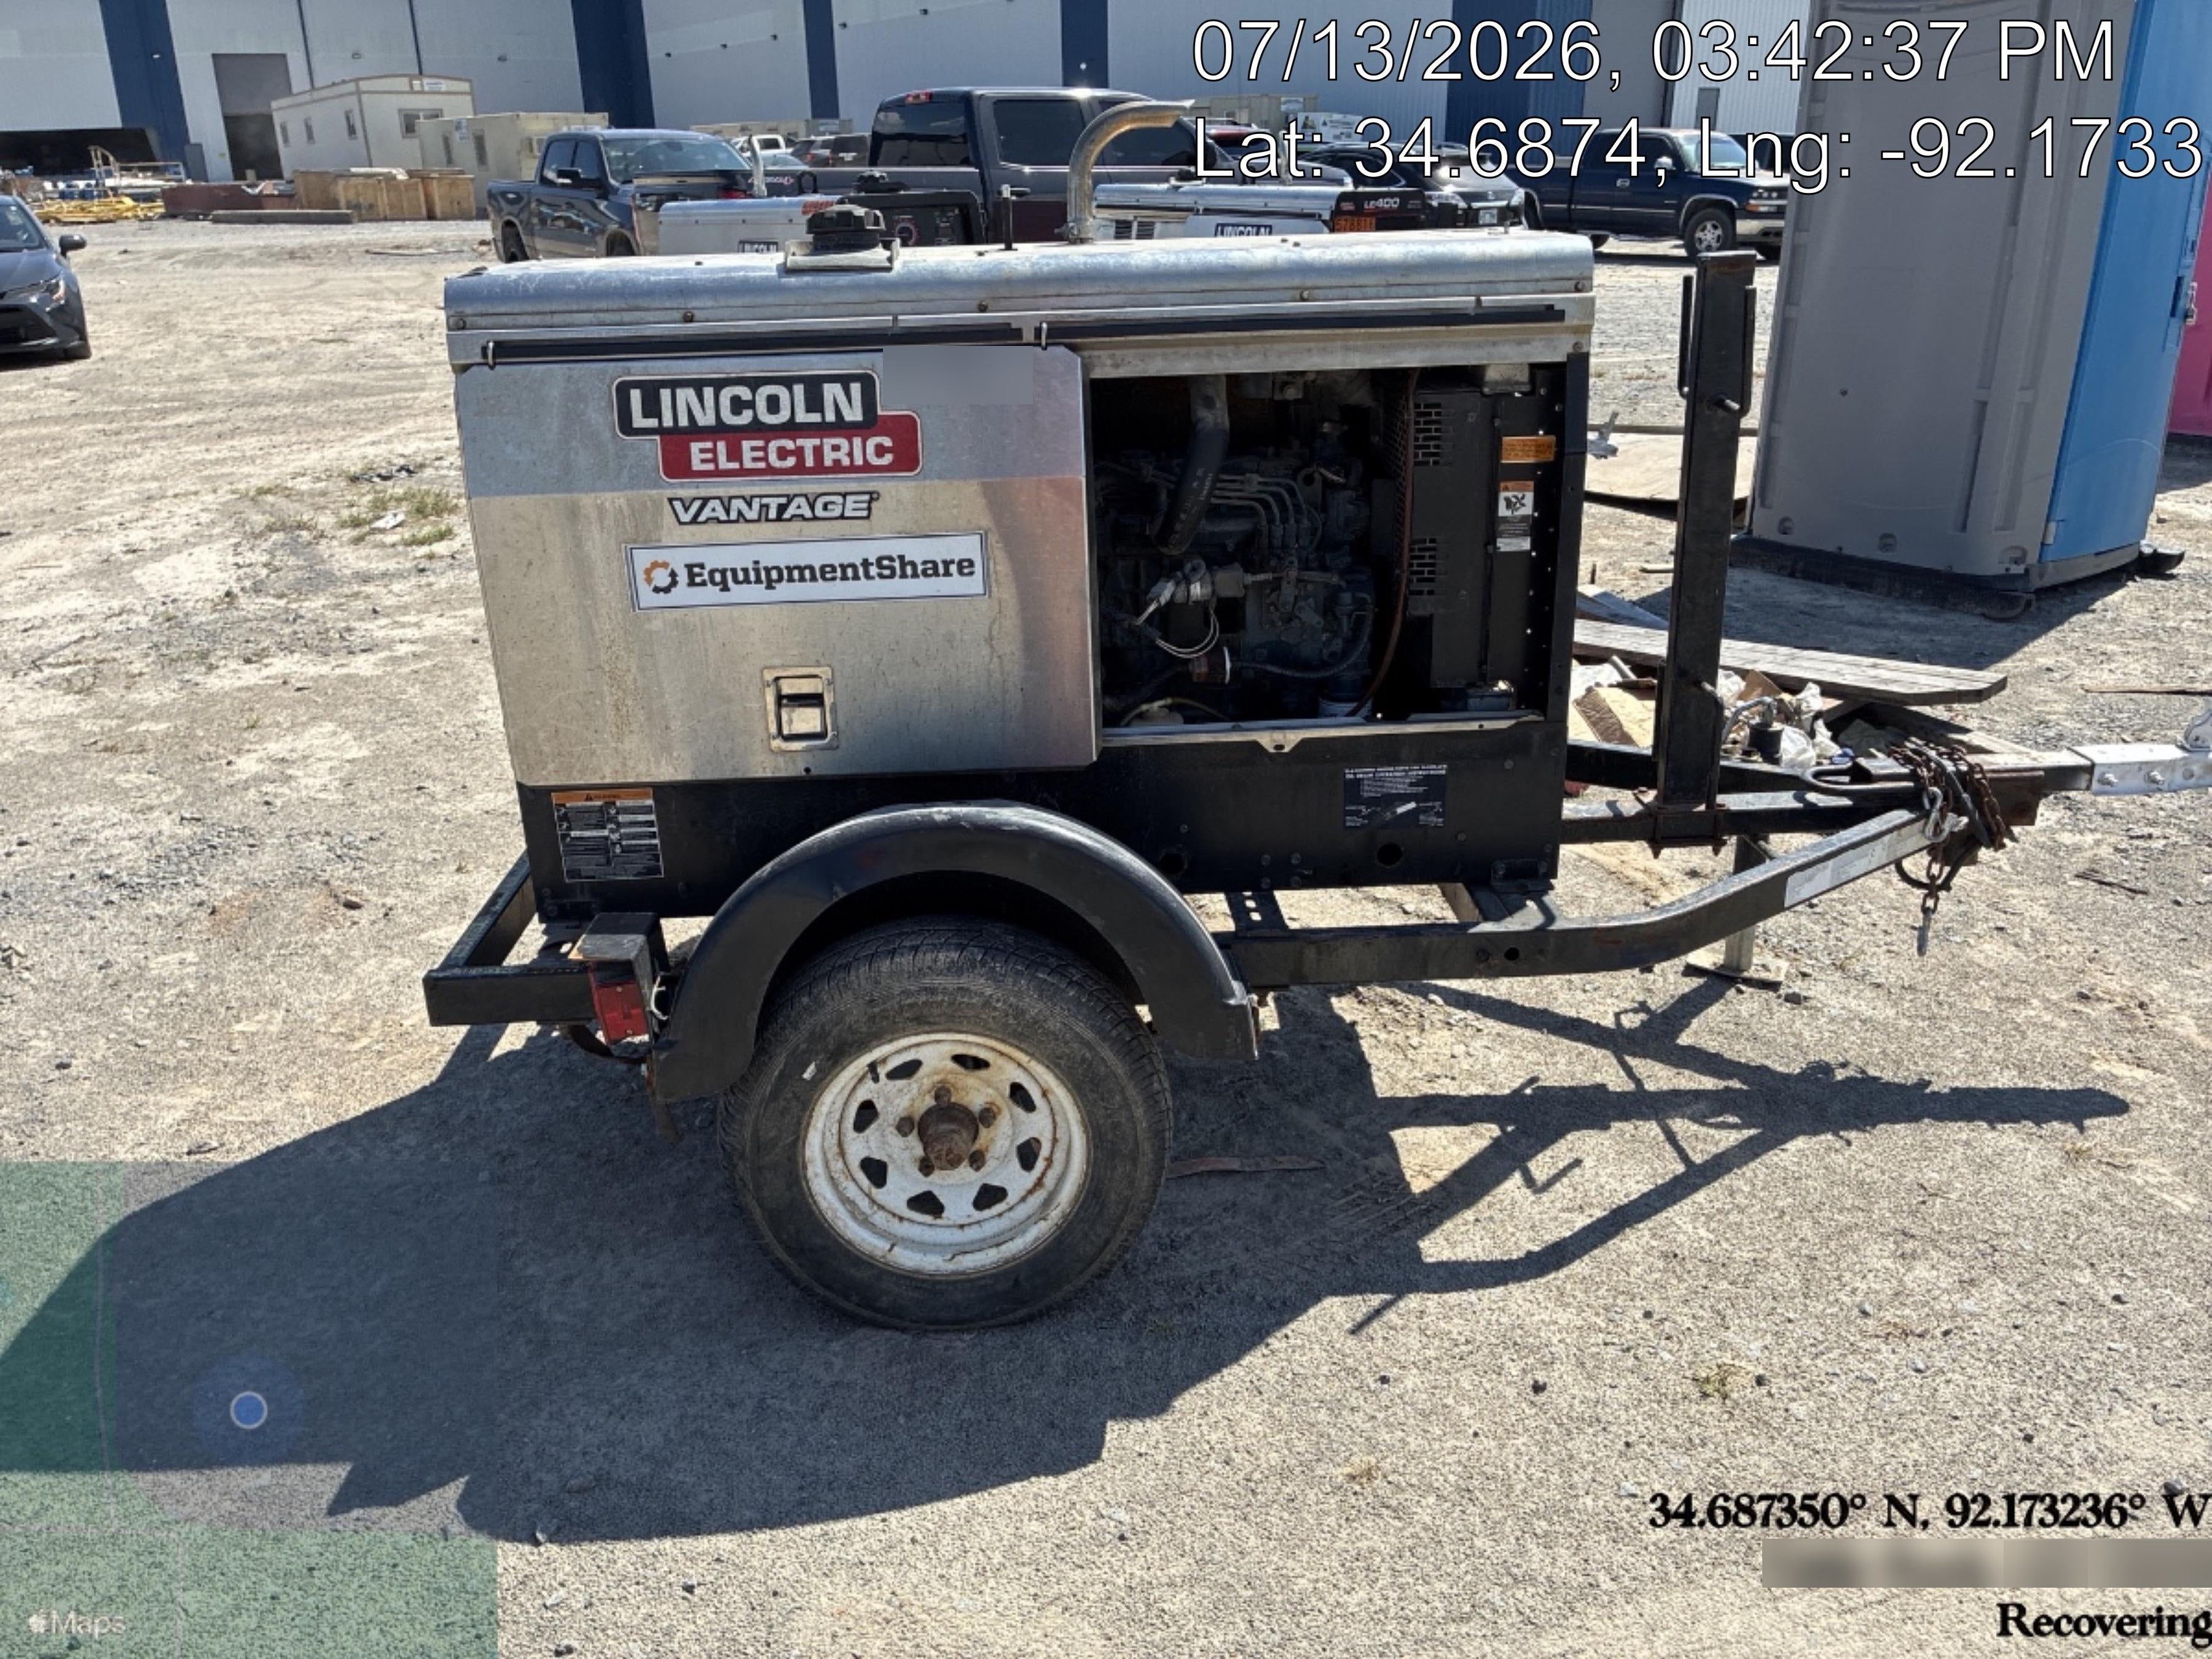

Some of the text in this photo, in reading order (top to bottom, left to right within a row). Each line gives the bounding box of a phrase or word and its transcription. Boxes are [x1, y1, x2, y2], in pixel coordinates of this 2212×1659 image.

[630, 382, 863, 428] LINCOLN
[690, 436, 893, 471] ELECTRIC
[671, 493, 871, 522] VANTAGE
[684, 554, 976, 592] EquipmentShare
